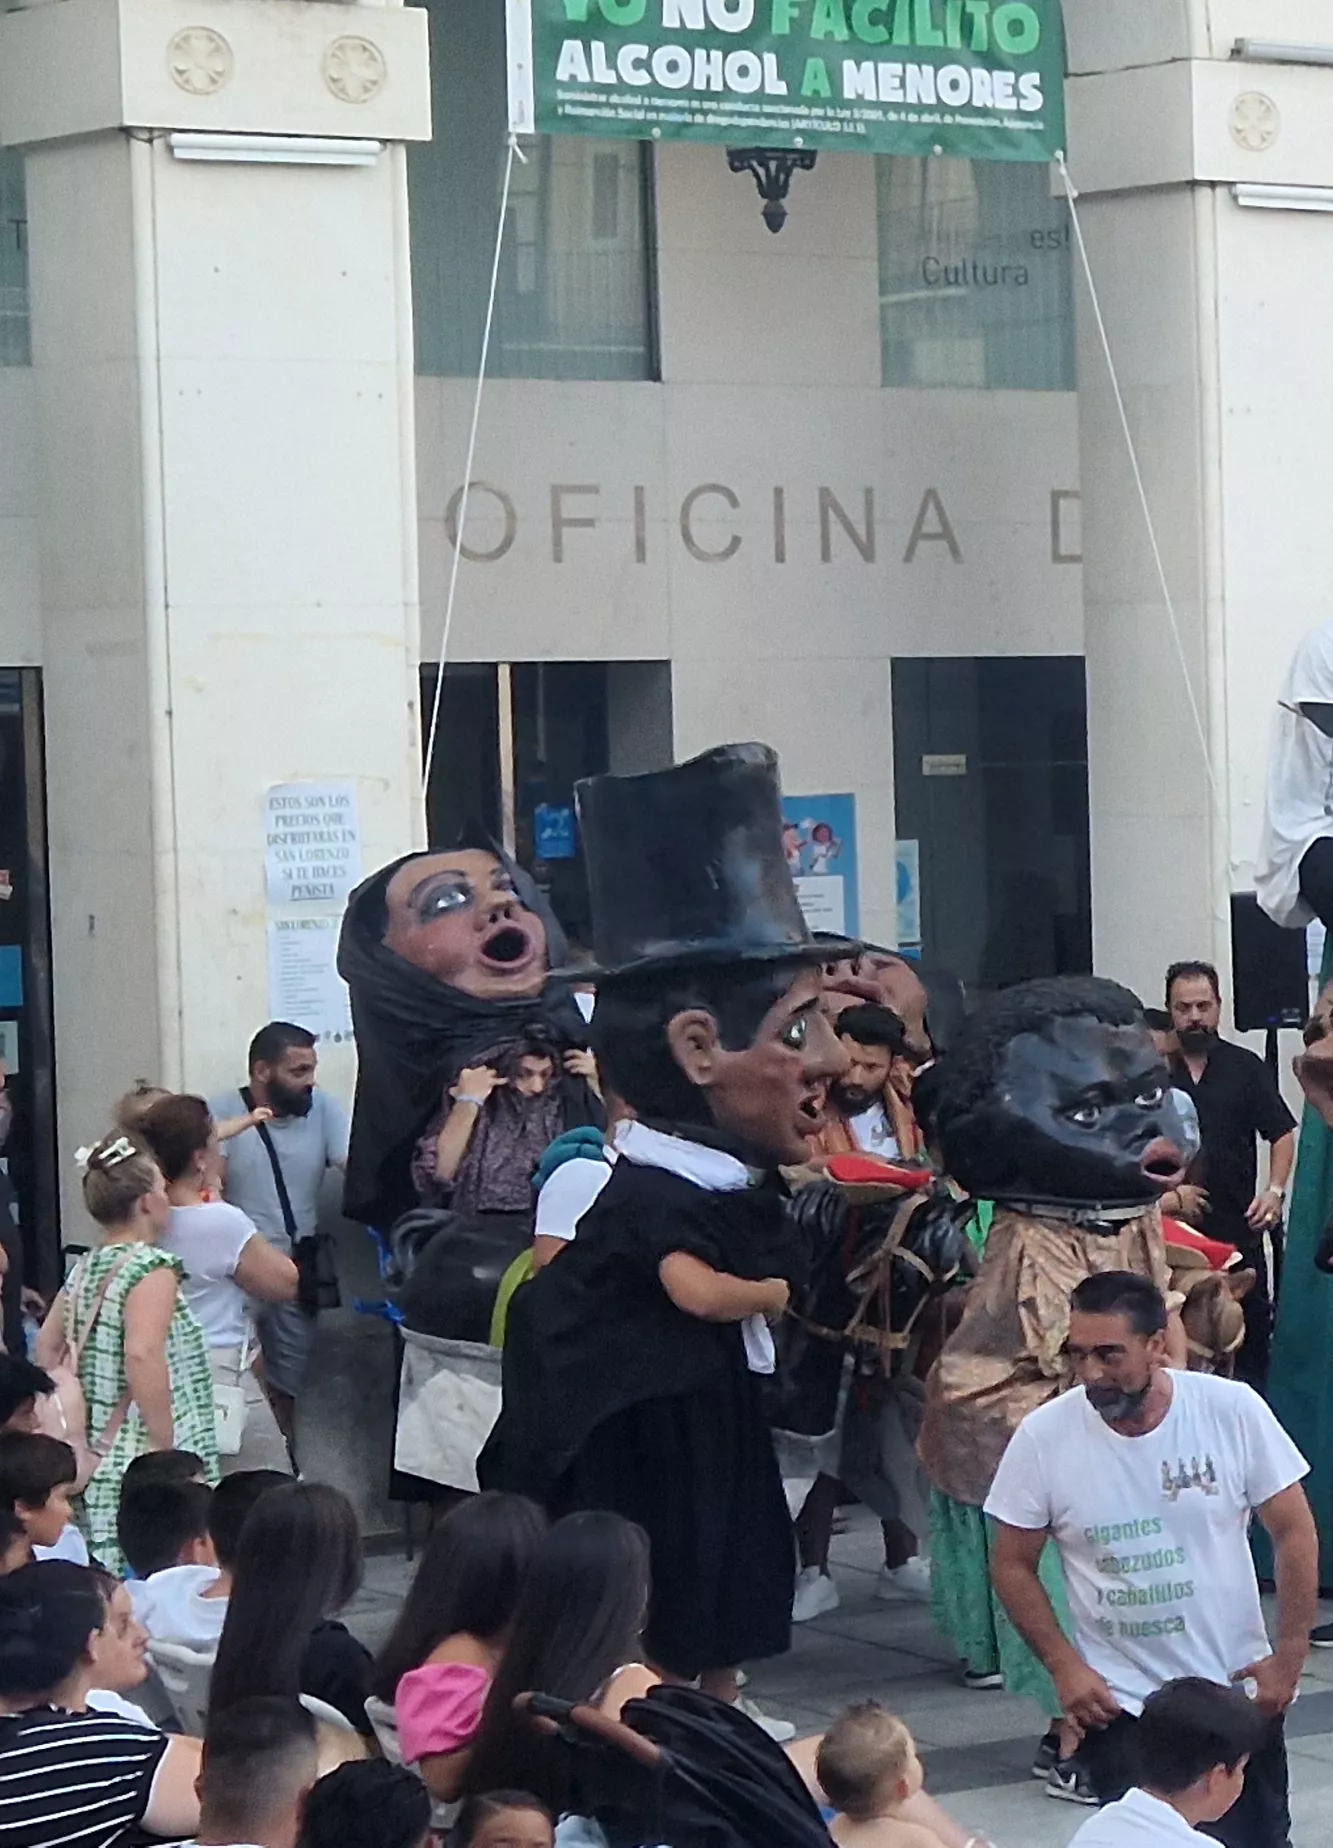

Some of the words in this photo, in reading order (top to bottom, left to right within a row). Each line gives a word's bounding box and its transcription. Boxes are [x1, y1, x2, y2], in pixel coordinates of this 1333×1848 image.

[661, 0, 756, 33] NO
[771, 0, 1041, 55] FACILITO
[555, 39, 787, 96] ALCOHOL
[801, 57, 832, 99] A
[843, 59, 1044, 112] MENORES
[922, 256, 1029, 286] Cultura
[444, 480, 964, 565] OFICINA
[305, 796, 327, 808] SON
[330, 795, 350, 807] LOS
